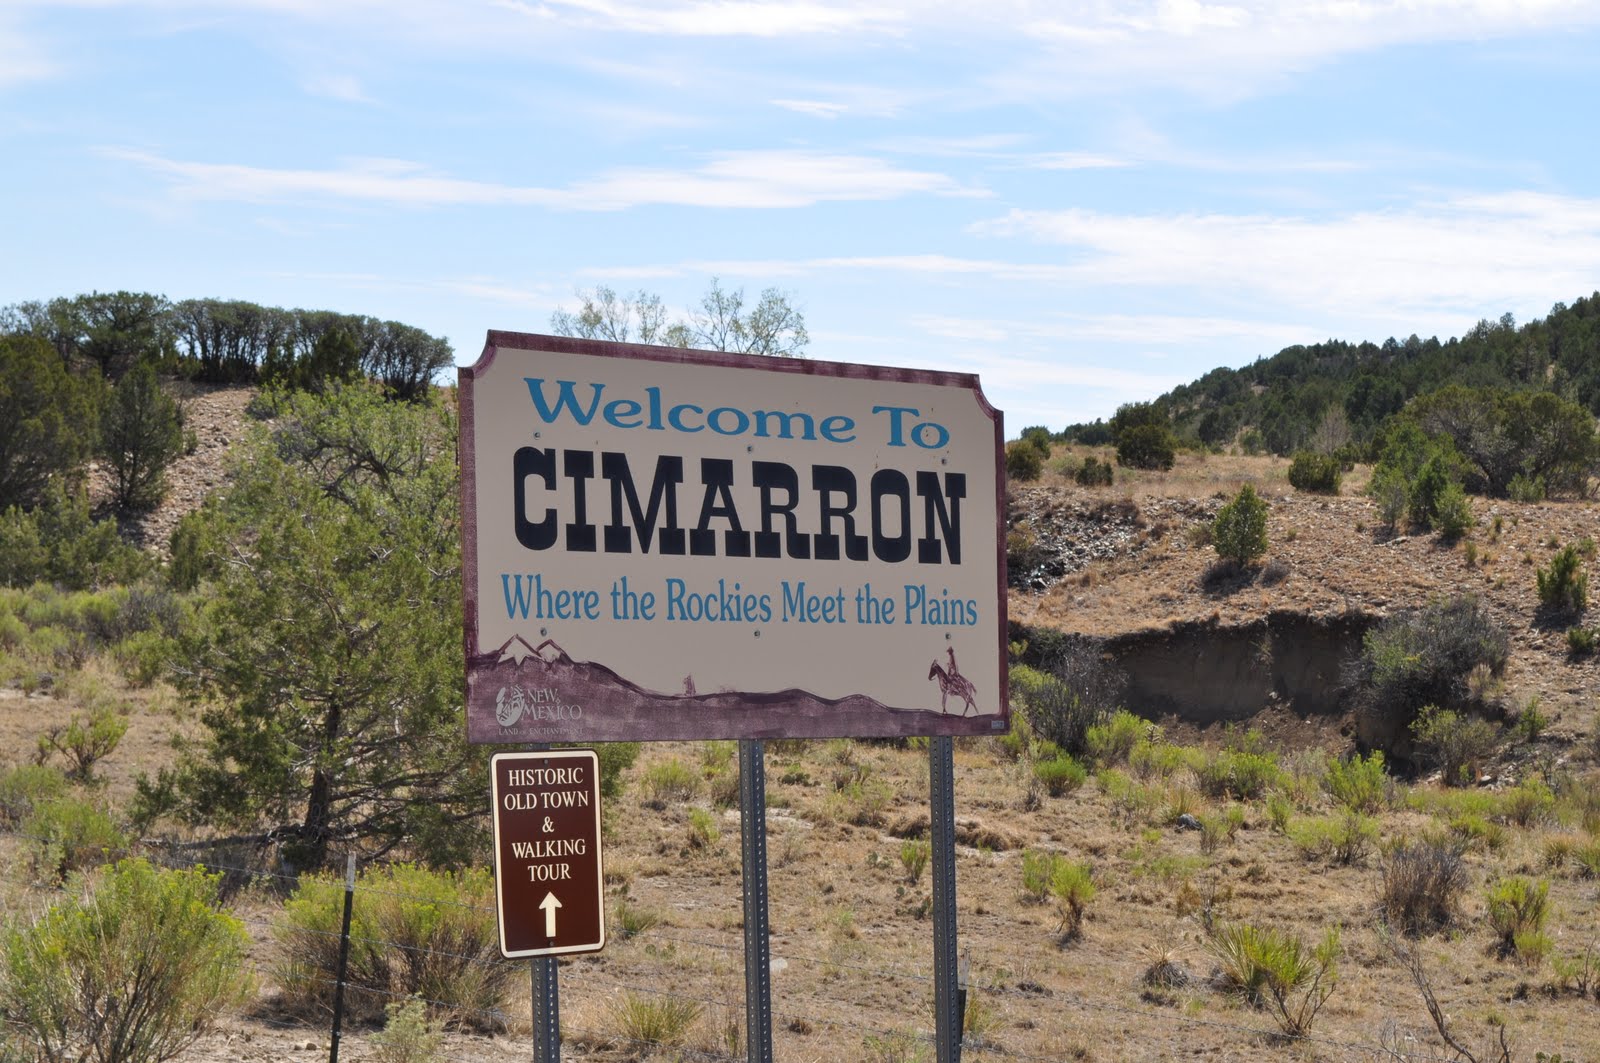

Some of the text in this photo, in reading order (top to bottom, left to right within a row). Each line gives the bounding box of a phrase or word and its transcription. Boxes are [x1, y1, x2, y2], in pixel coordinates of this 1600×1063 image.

[523, 377, 950, 449] Welcome To
[513, 446, 966, 565] CIMARRON
[501, 574, 978, 626] Where the Rockies Meet the Plains
[521, 704, 582, 721] MEXICO
[498, 727, 519, 736] LAND
[508, 767, 584, 787] HISTORIC
[504, 790, 589, 811] OLD TOWN
[542, 816, 555, 833] &
[512, 838, 586, 859] WALKING
[527, 863, 571, 882] TOUR
